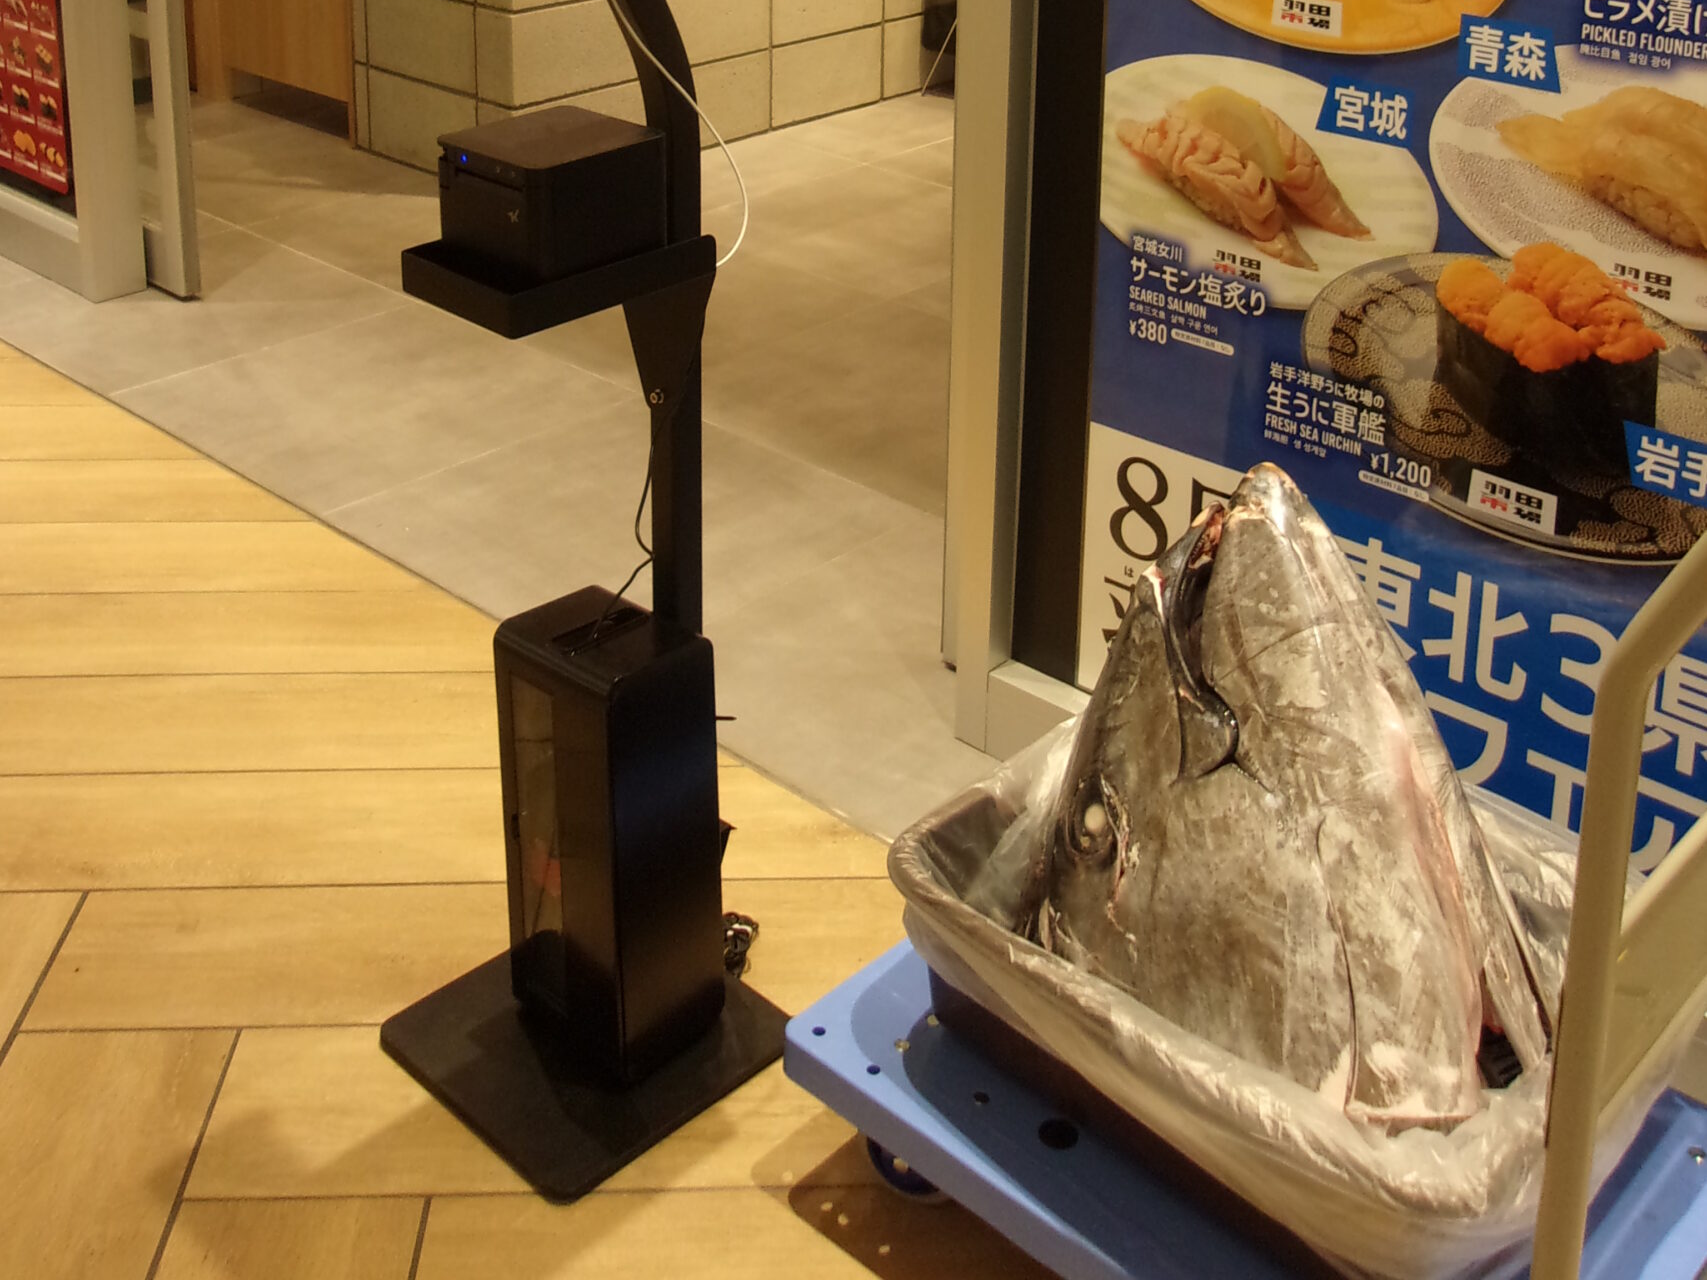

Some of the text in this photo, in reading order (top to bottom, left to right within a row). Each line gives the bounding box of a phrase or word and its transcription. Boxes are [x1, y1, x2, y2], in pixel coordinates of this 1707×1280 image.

[1465, 24, 1547, 82] 青森
[1581, 23, 1636, 48] PICKLED
[1334, 85, 1409, 141] 宮城
[1132, 235, 1183, 263] 宮城女川
[1129, 285, 1207, 319] SEARED SALMON
[1130, 256, 1266, 316] サーモン塩炙り
[1129, 318, 1168, 345] ¥380
[1269, 361, 1385, 410] 岩手洋野うに牧場の
[1265, 380, 1386, 446] 生うに軍艦
[1265, 413, 1362, 457] FRESH SEA URCHIN
[1370, 452, 1432, 488] ¥1,200
[1634, 435, 1707, 498] 岩手
